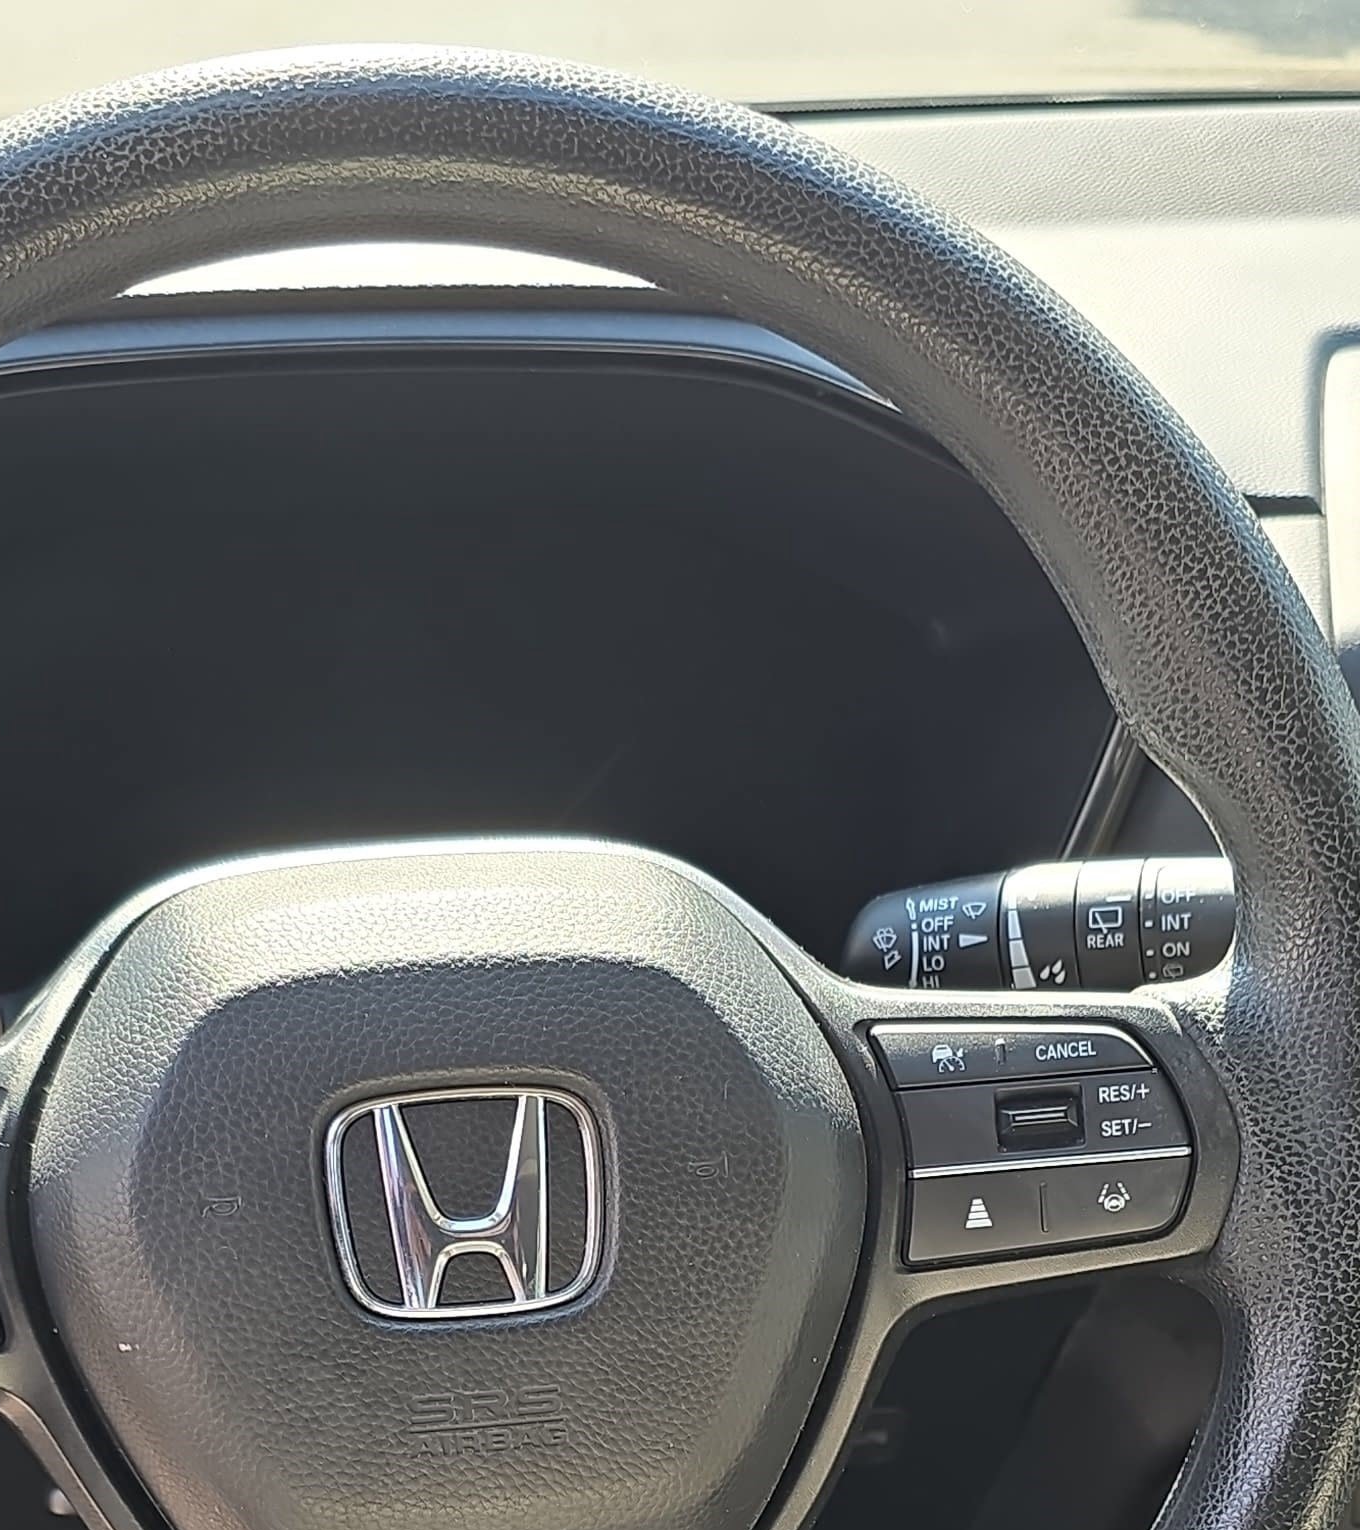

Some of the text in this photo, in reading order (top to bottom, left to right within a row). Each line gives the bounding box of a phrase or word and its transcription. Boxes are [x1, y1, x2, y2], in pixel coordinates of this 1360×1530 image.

[919, 896, 960, 914] MIST
[1160, 888, 1196, 905] OFF
[921, 915, 955, 933] OFF
[1160, 913, 1193, 931] INT
[922, 935, 951, 952] INT
[1086, 932, 1125, 950] REAR
[1162, 942, 1191, 959] ON
[922, 955, 945, 973] LO
[1035, 1041, 1097, 1062] CANCEL
[406, 1384, 563, 1424] SRS
[410, 1426, 569, 1458] AIRBAG
